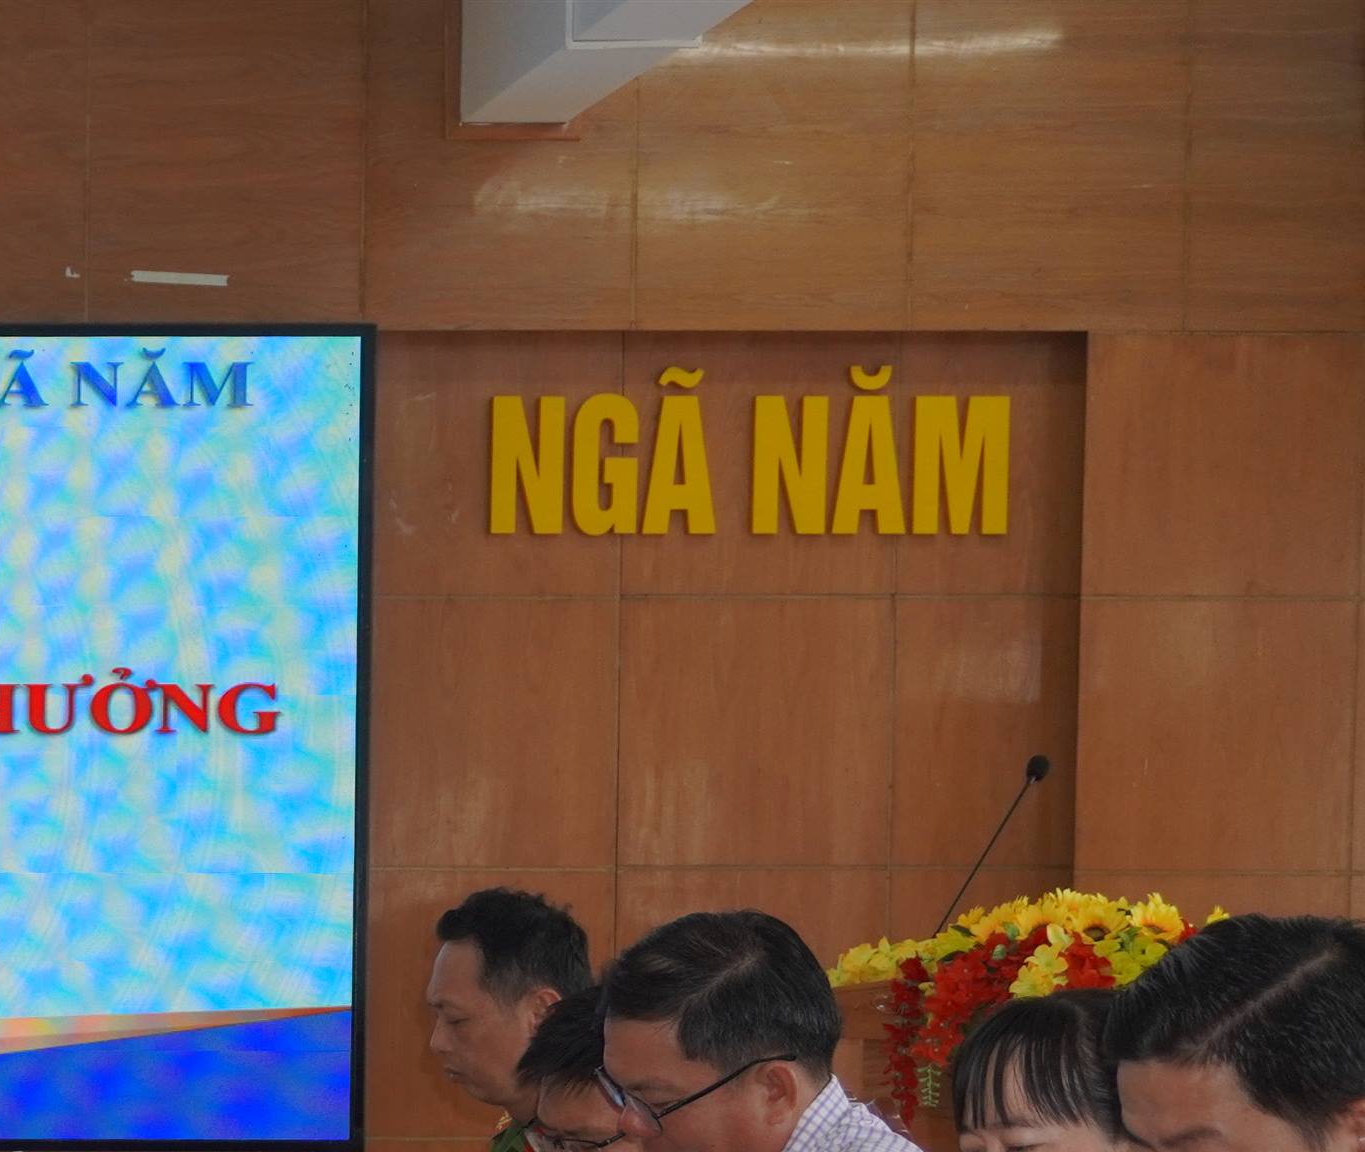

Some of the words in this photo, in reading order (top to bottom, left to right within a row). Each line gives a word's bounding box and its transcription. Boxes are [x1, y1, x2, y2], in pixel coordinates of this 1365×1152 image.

[68, 347, 255, 409] NĂM
[490, 366, 716, 536] NGÃ
[751, 365, 1010, 535] NĂM
